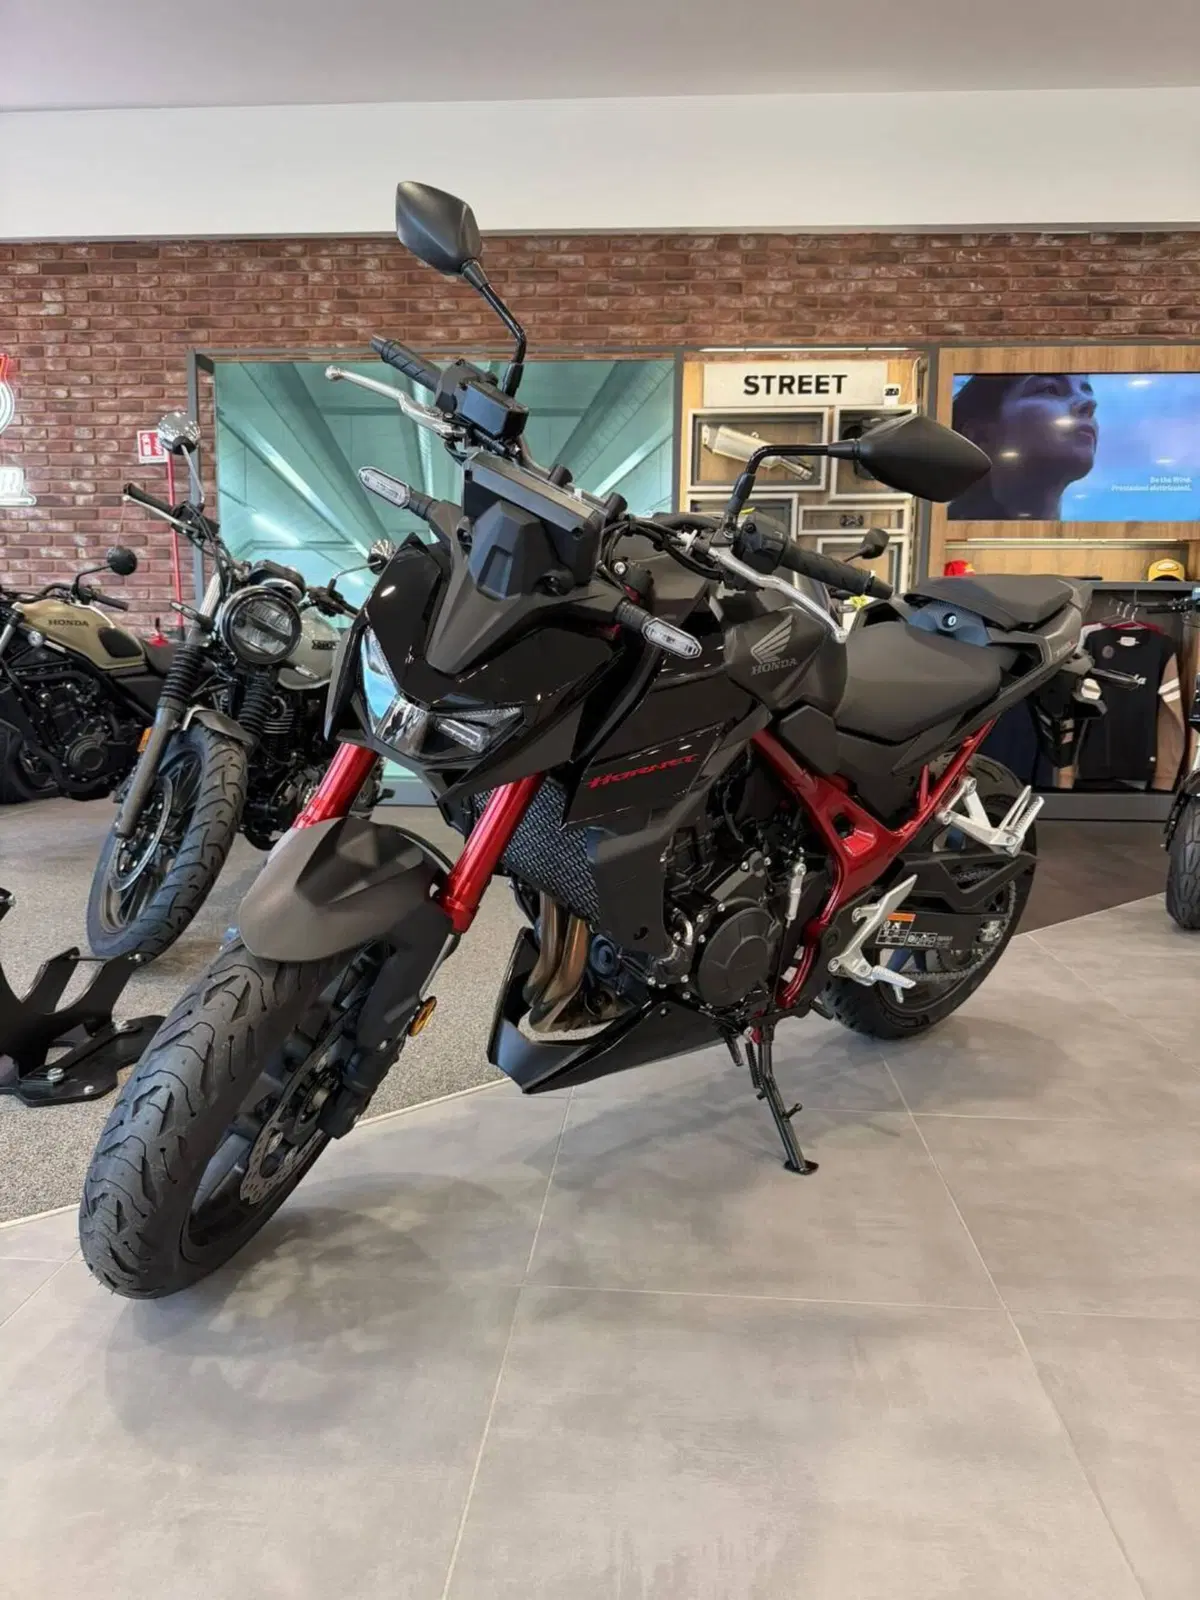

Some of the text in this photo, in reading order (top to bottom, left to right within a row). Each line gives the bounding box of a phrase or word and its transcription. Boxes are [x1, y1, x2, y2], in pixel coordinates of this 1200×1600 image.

[743, 374, 848, 396] STREET
[48, 619, 90, 628] HONDA
[751, 657, 798, 676] HONDA
